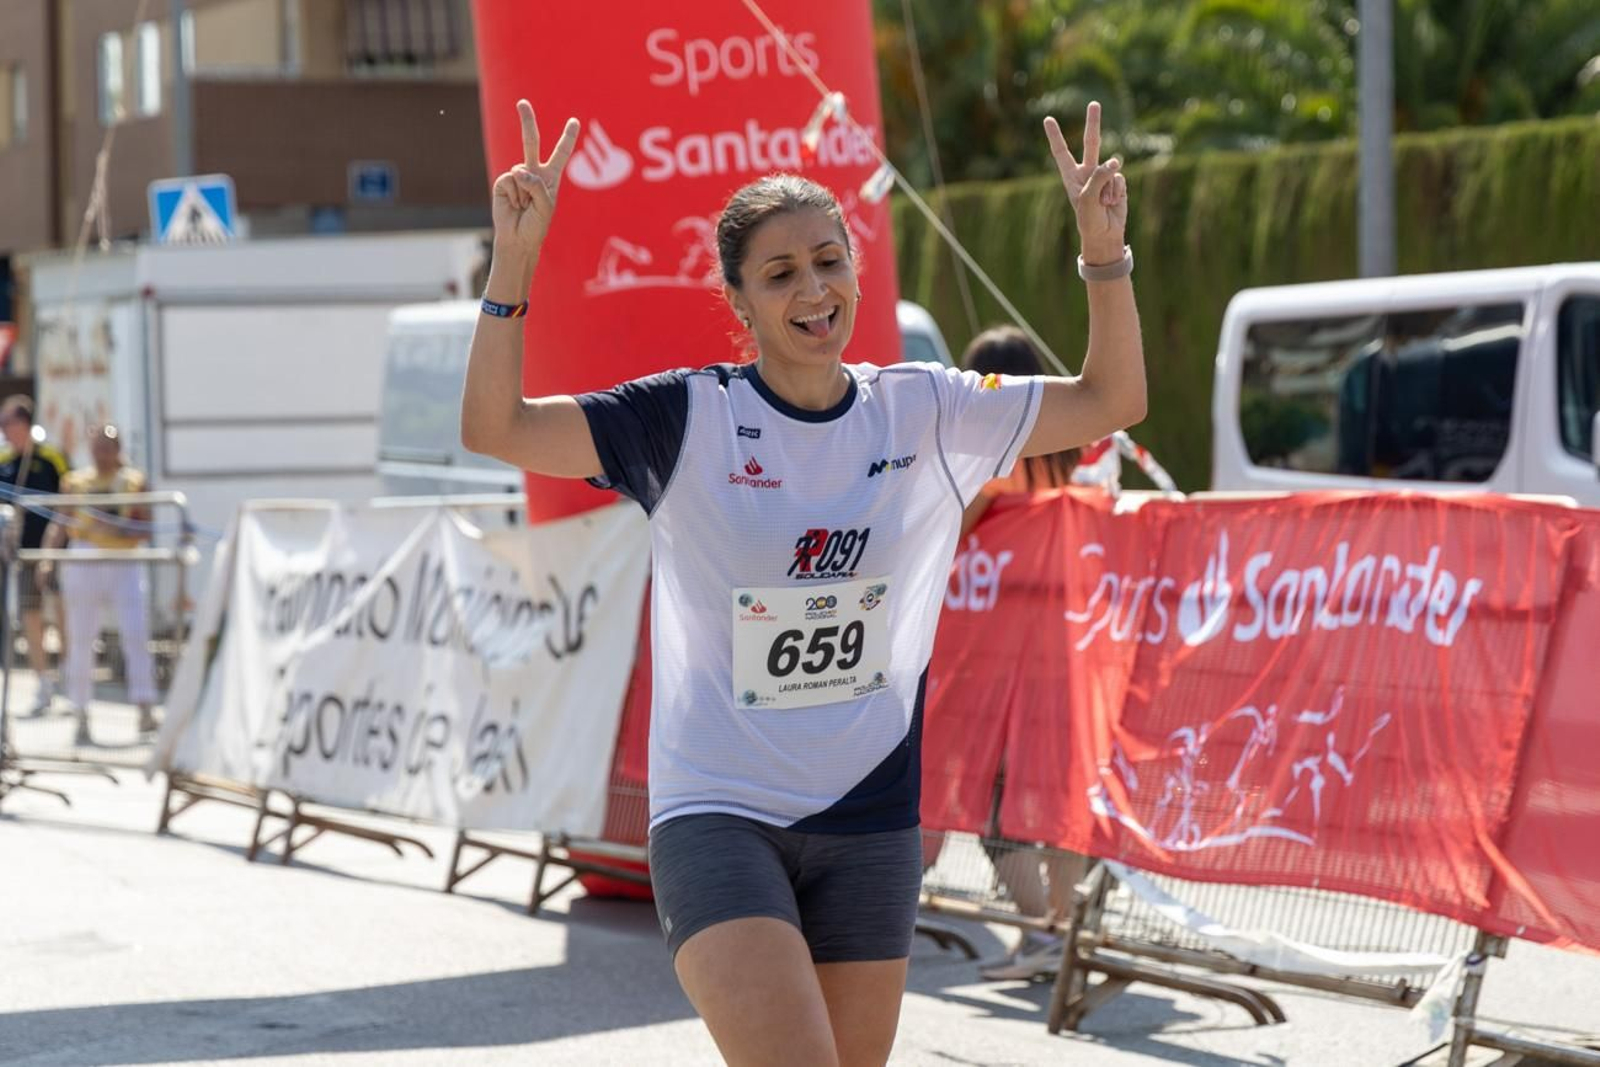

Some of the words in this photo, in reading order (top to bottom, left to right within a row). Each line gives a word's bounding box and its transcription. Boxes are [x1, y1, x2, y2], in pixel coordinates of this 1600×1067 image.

[646, 27, 820, 96] Sports
[728, 472, 782, 489] Santander
[767, 620, 864, 677] 659
[778, 682, 802, 693] LAURA
[803, 679, 828, 690] ROMAN
[829, 676, 857, 688] PERALTA
